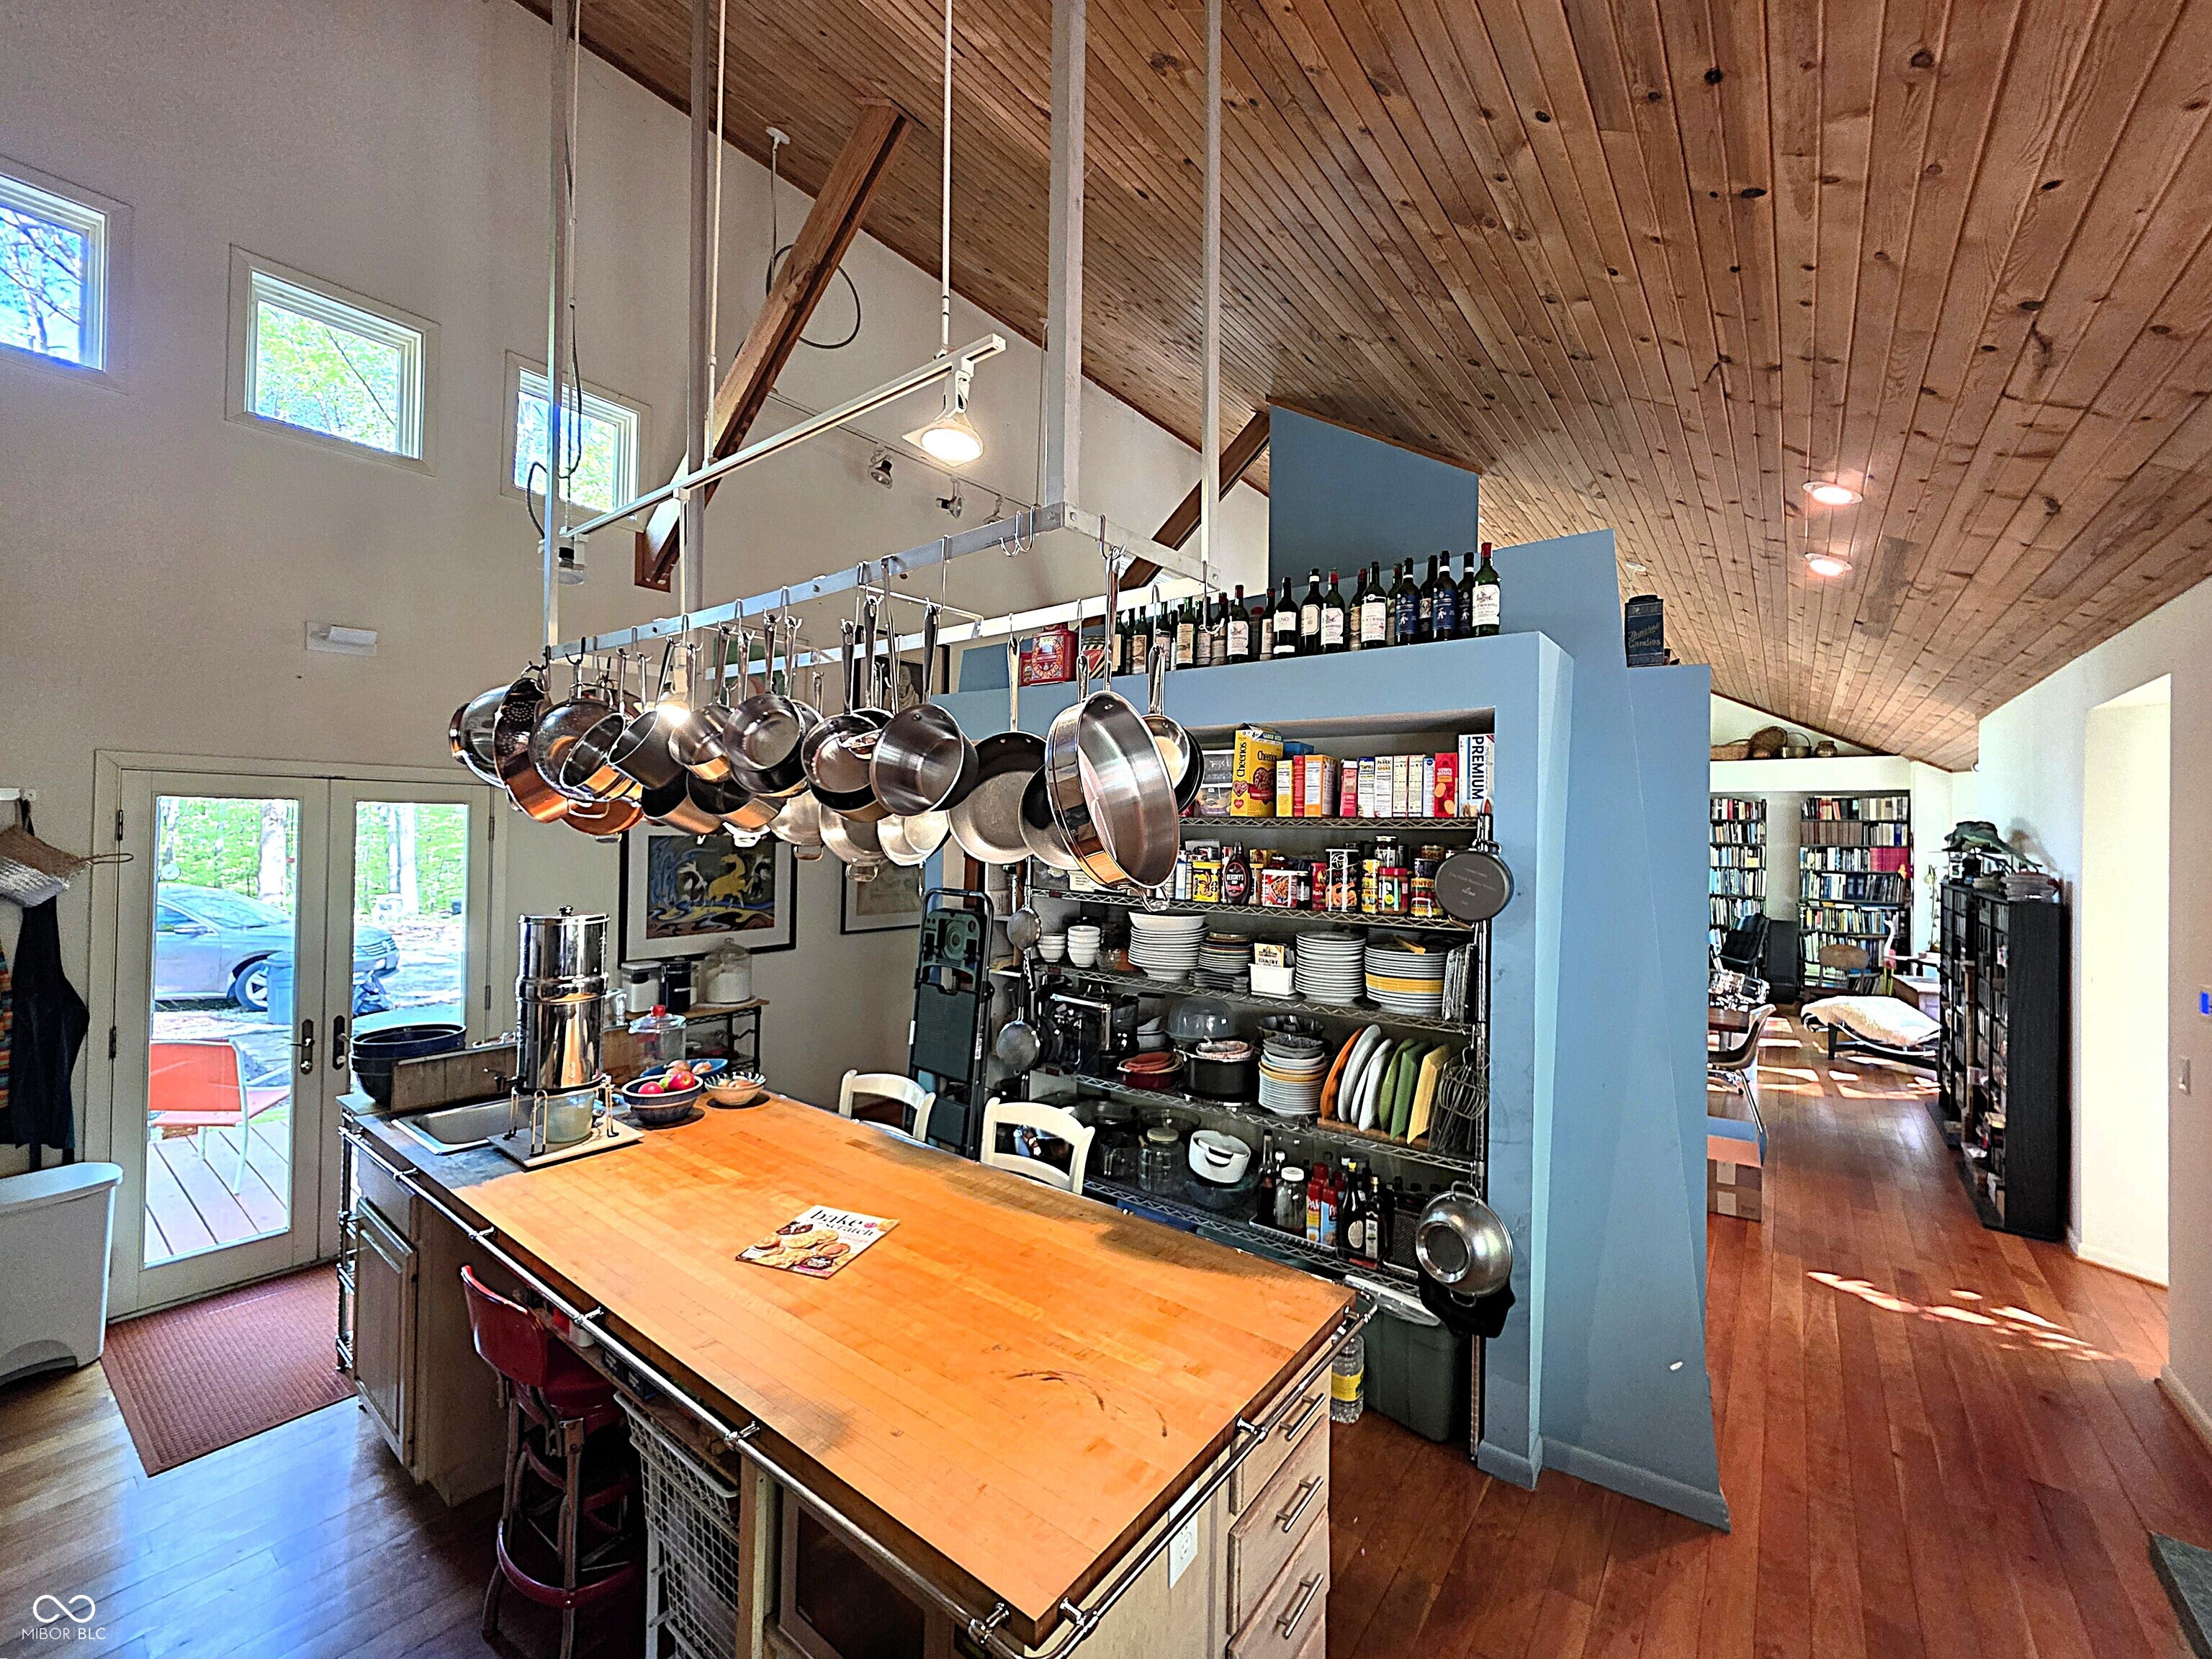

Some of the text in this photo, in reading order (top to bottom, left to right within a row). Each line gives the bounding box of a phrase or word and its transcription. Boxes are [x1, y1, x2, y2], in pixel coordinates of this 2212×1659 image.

[1628, 638, 1661, 648] Candies
[1471, 736, 1484, 800] PREMIUM
[809, 1209, 863, 1227] bake
